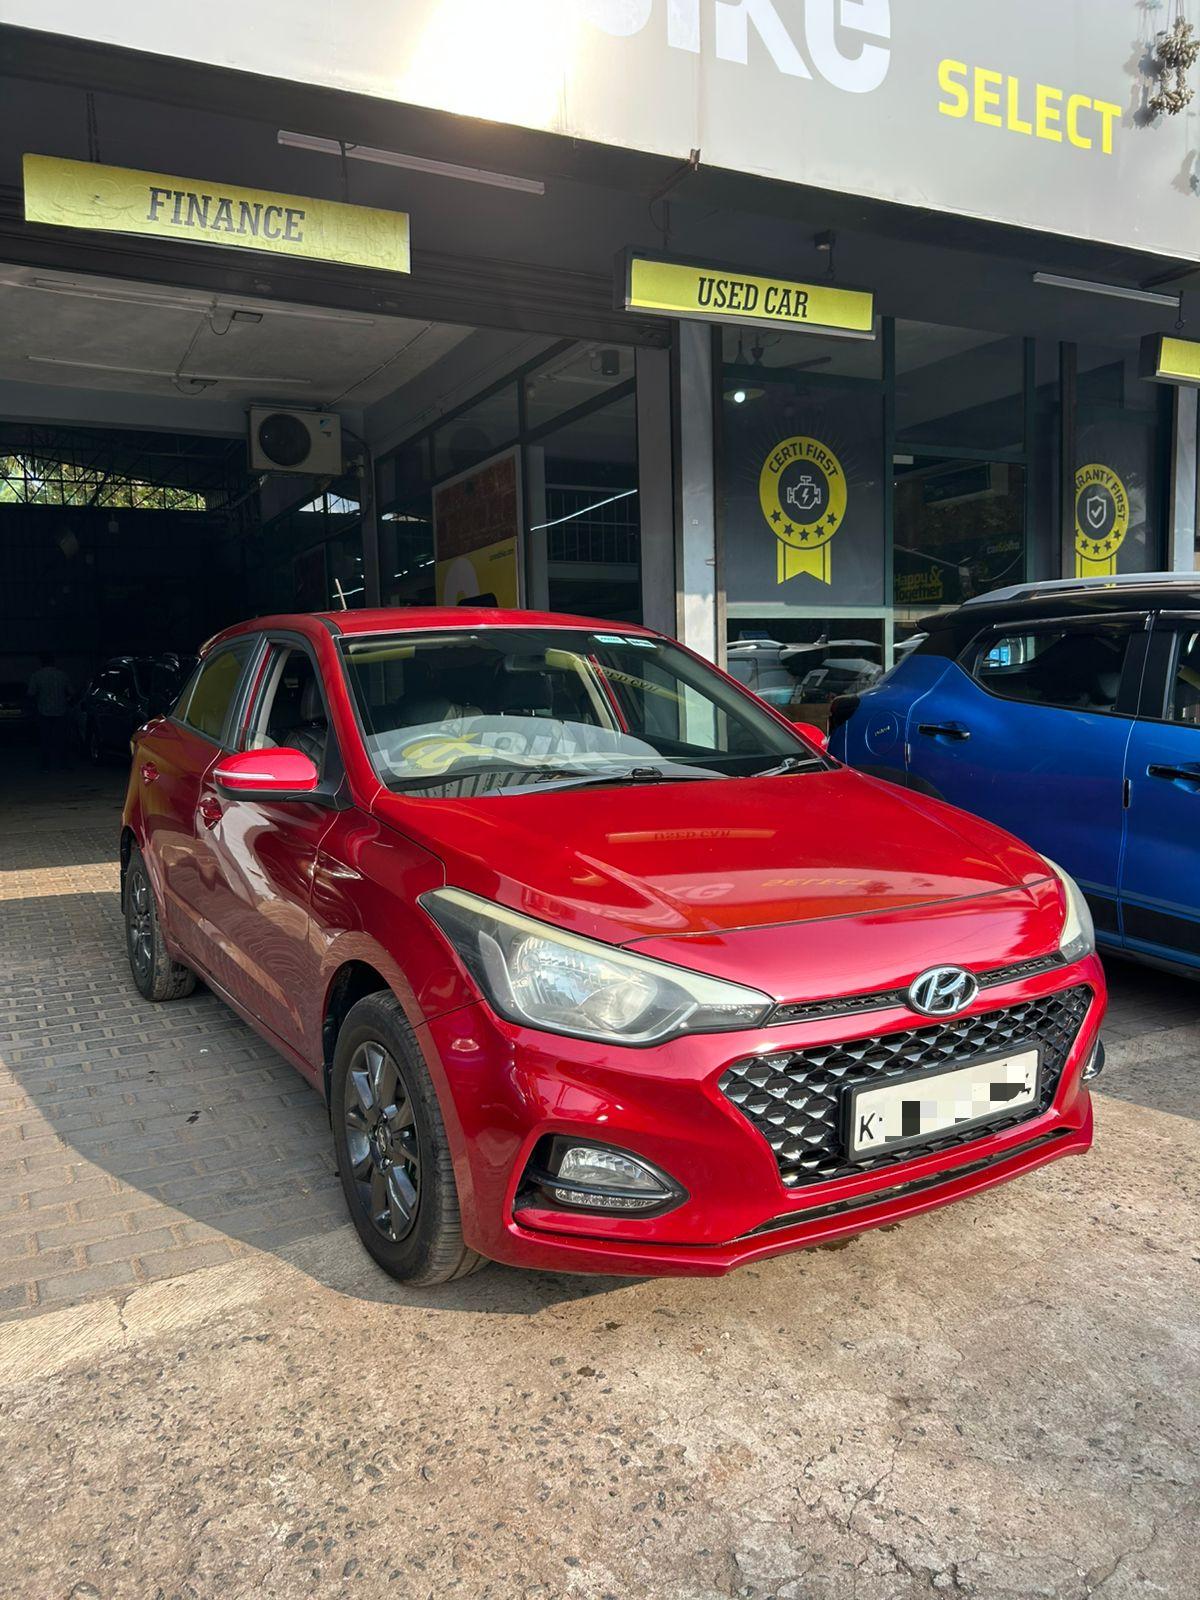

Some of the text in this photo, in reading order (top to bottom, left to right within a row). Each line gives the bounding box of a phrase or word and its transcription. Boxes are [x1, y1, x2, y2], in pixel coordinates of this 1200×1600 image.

[938, 58, 1122, 155] SELECT
[146, 186, 305, 242] FINANCE
[698, 277, 809, 318] USED CAR
[768, 442, 838, 477] CERTI FIRST
[1110, 482, 1126, 521] FIRST
